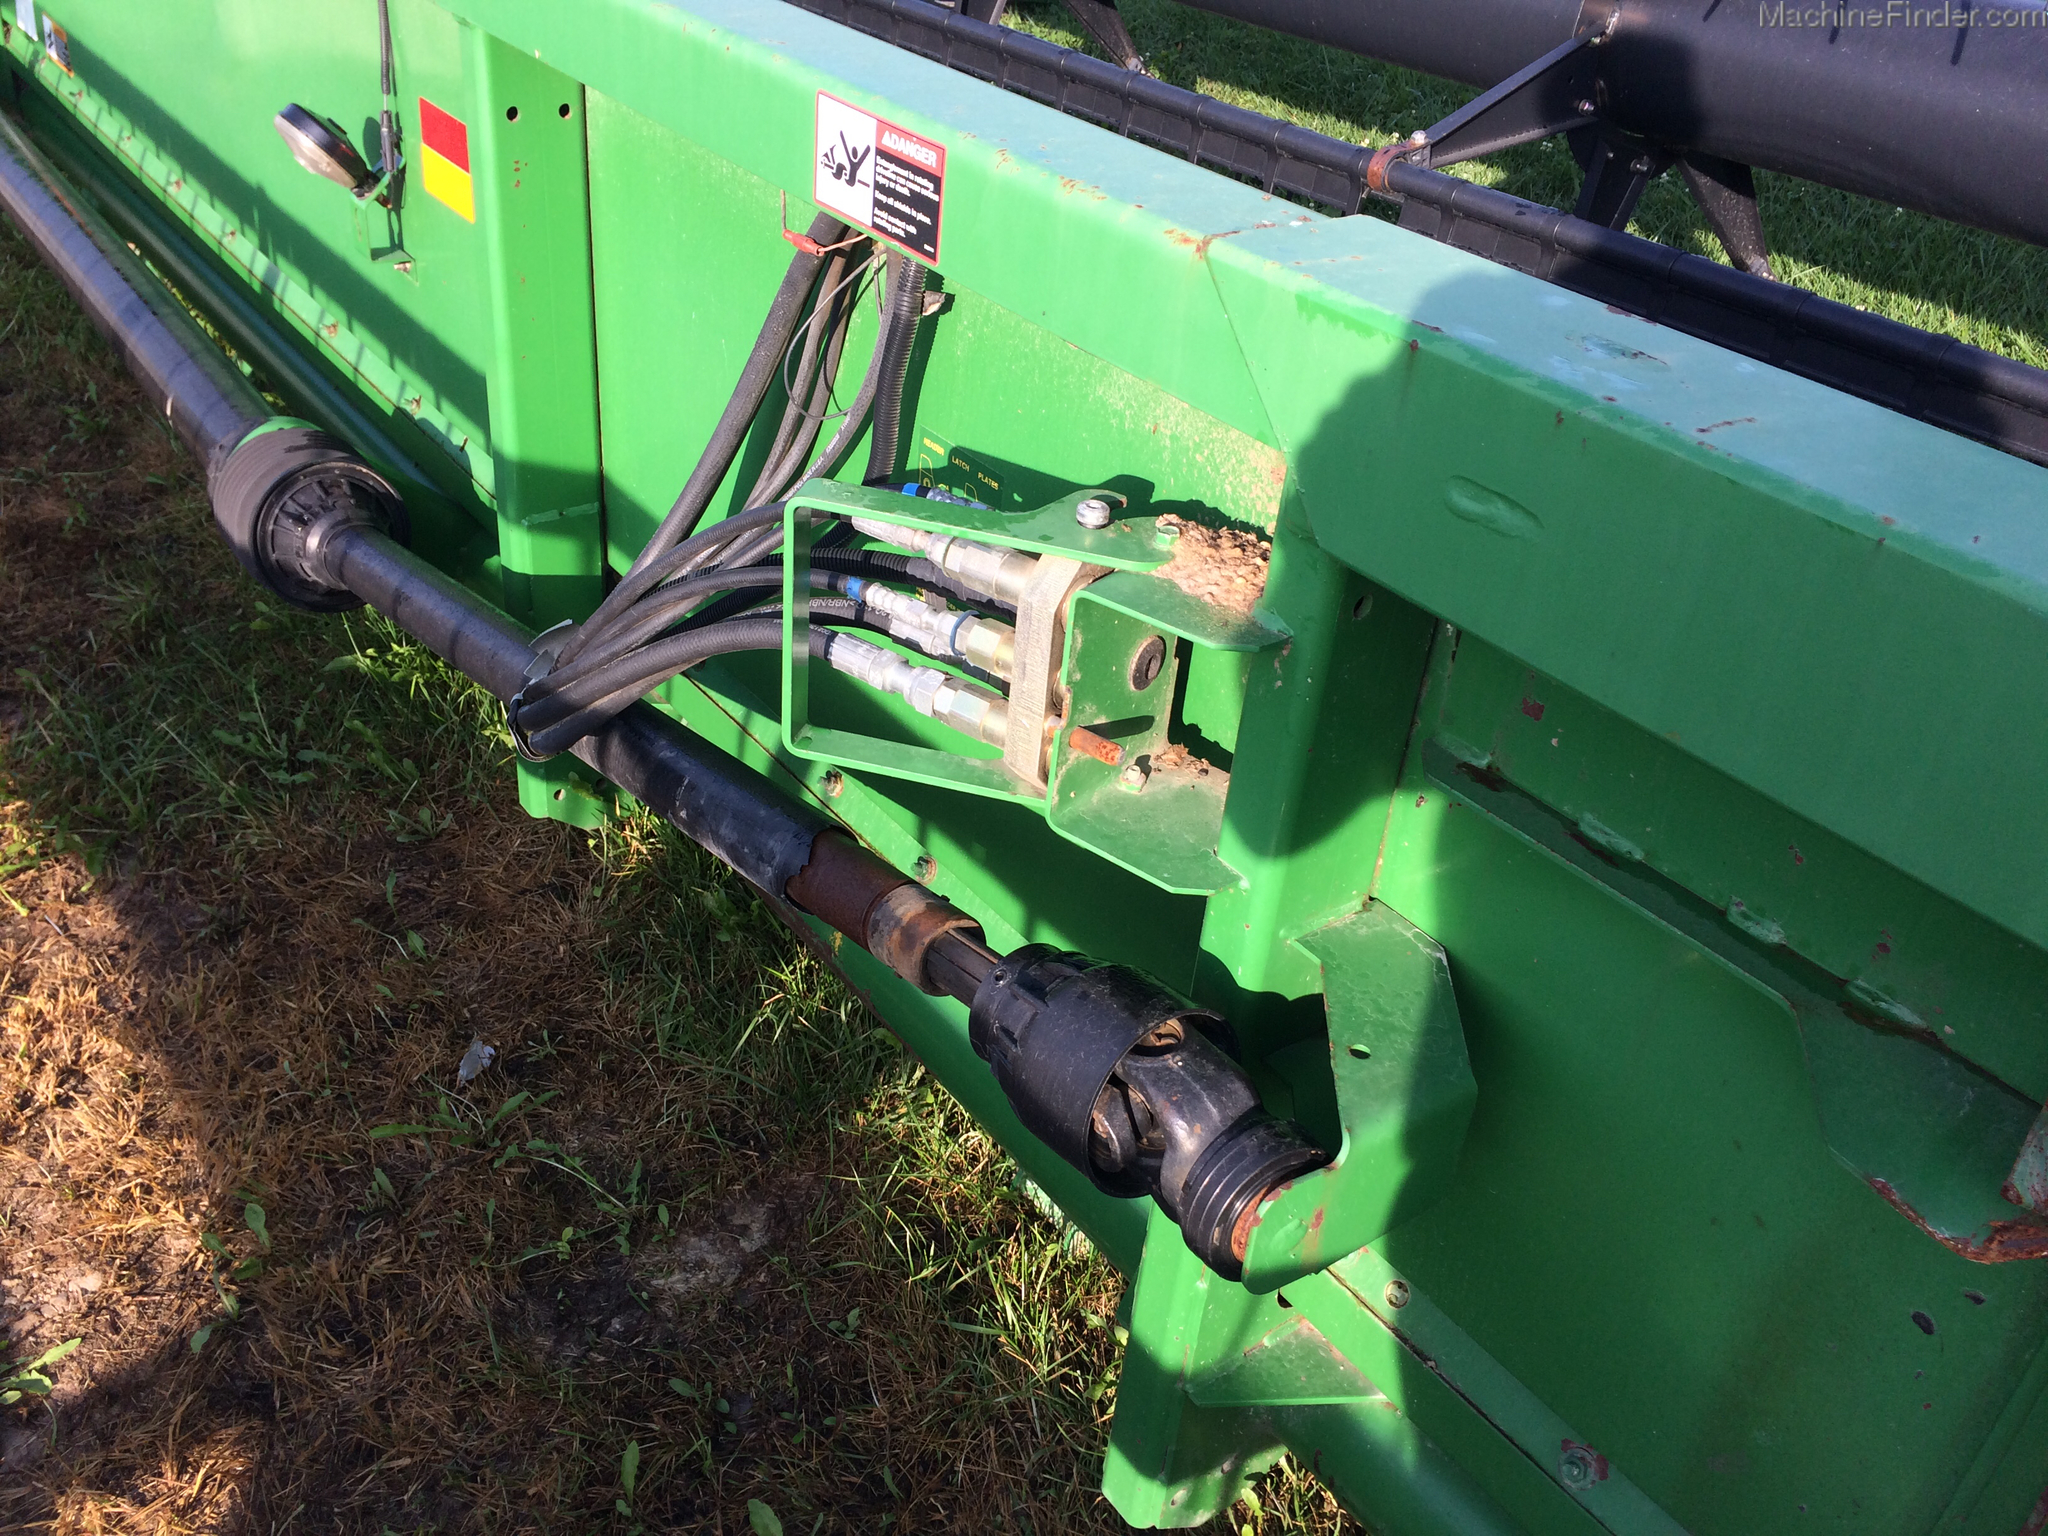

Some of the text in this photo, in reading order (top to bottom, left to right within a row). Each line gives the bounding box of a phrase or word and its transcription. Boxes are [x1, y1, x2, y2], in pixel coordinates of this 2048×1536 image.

[891, 133, 937, 168] DANGER
[951, 455, 970, 472] LATCH
[977, 471, 999, 490] PLATES
